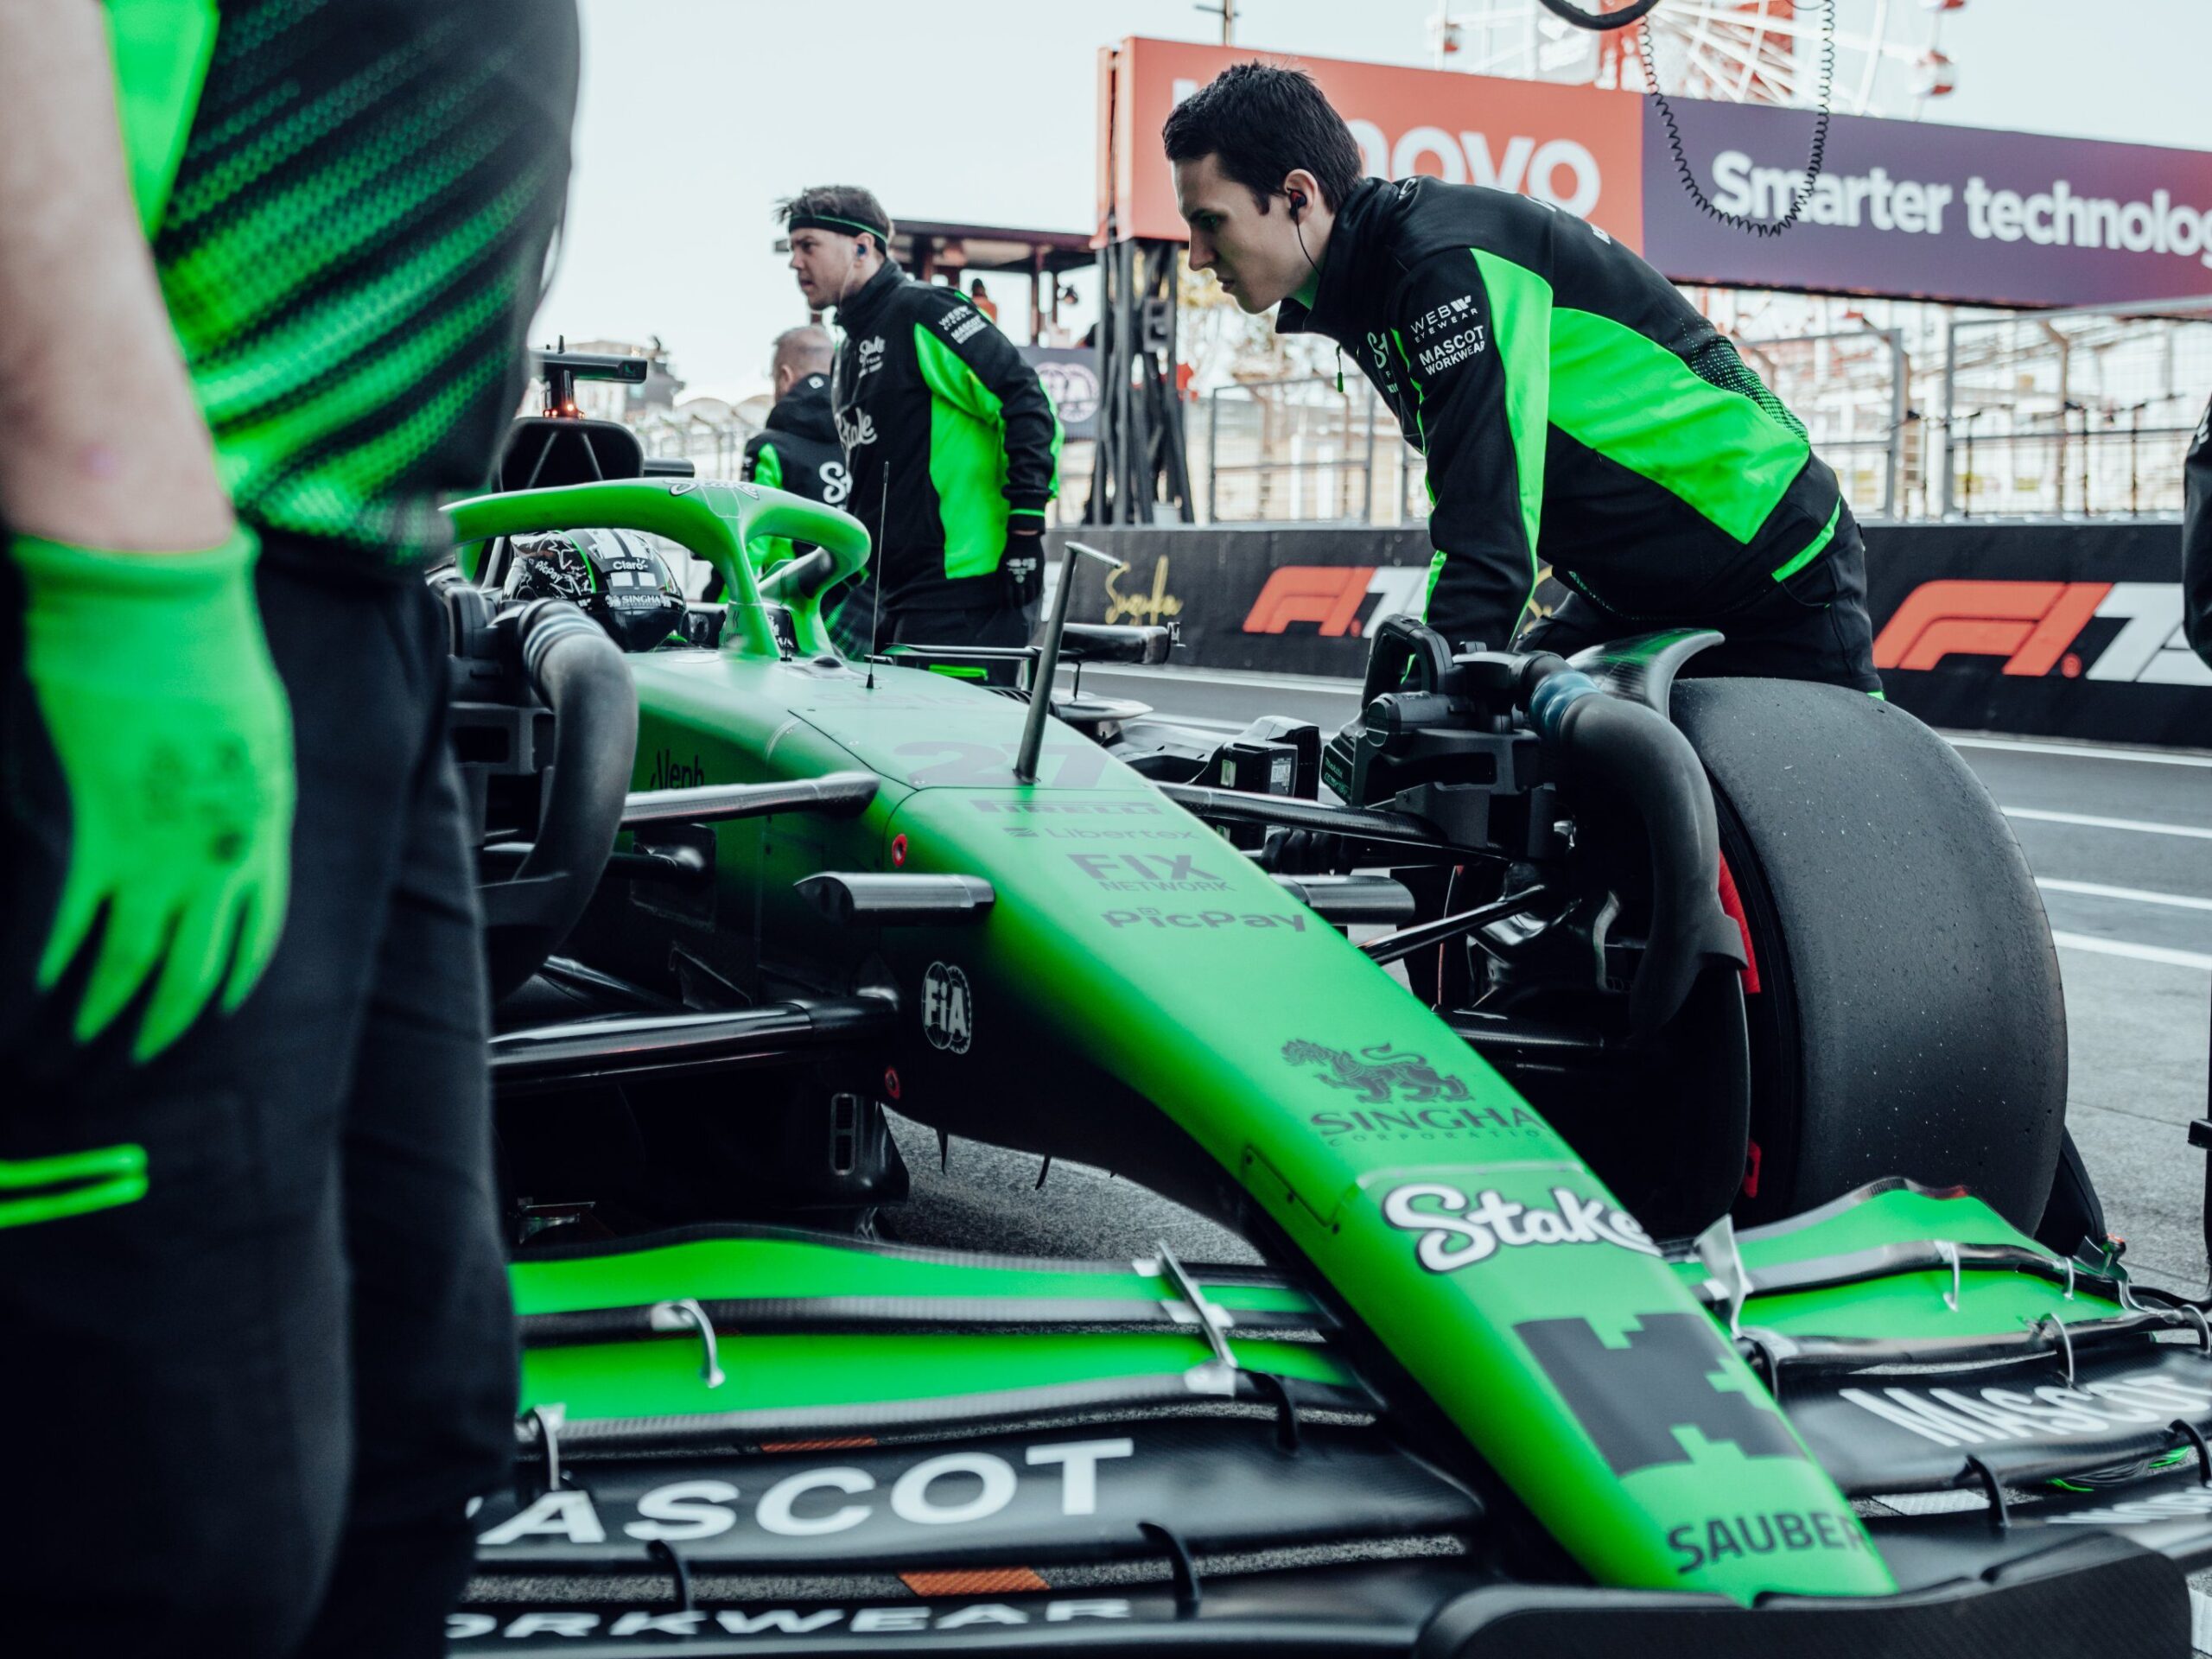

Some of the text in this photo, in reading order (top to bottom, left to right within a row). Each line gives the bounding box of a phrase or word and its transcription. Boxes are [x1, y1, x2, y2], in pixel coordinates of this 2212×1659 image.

[1711, 150, 1953, 234] Smarter
[1410, 304, 1452, 334] WEB
[1414, 308, 1478, 344] EYEWEAR
[1419, 325, 1484, 366] MASCOT
[1425, 340, 1485, 376] WORKWEAR
[535, 560, 563, 584] PicPay
[613, 558, 645, 570] Claro
[622, 594, 662, 606] SINGHA
[893, 741, 1110, 786] 27
[968, 799, 1164, 816] PIRELLI
[1044, 826, 1201, 841] Libertex
[1065, 854, 1225, 881] FIX
[1096, 880, 1238, 893] NETWORK
[1100, 906, 1307, 933] PicPay
[1310, 1106, 1550, 1137] SINGHA
[1328, 1128, 1555, 1148] CORPORATIO
[1383, 1182, 1665, 1274] Stake
[466, 1437, 1135, 1545] ASCOT
[444, 1599, 1133, 1639] ORKWEAR
